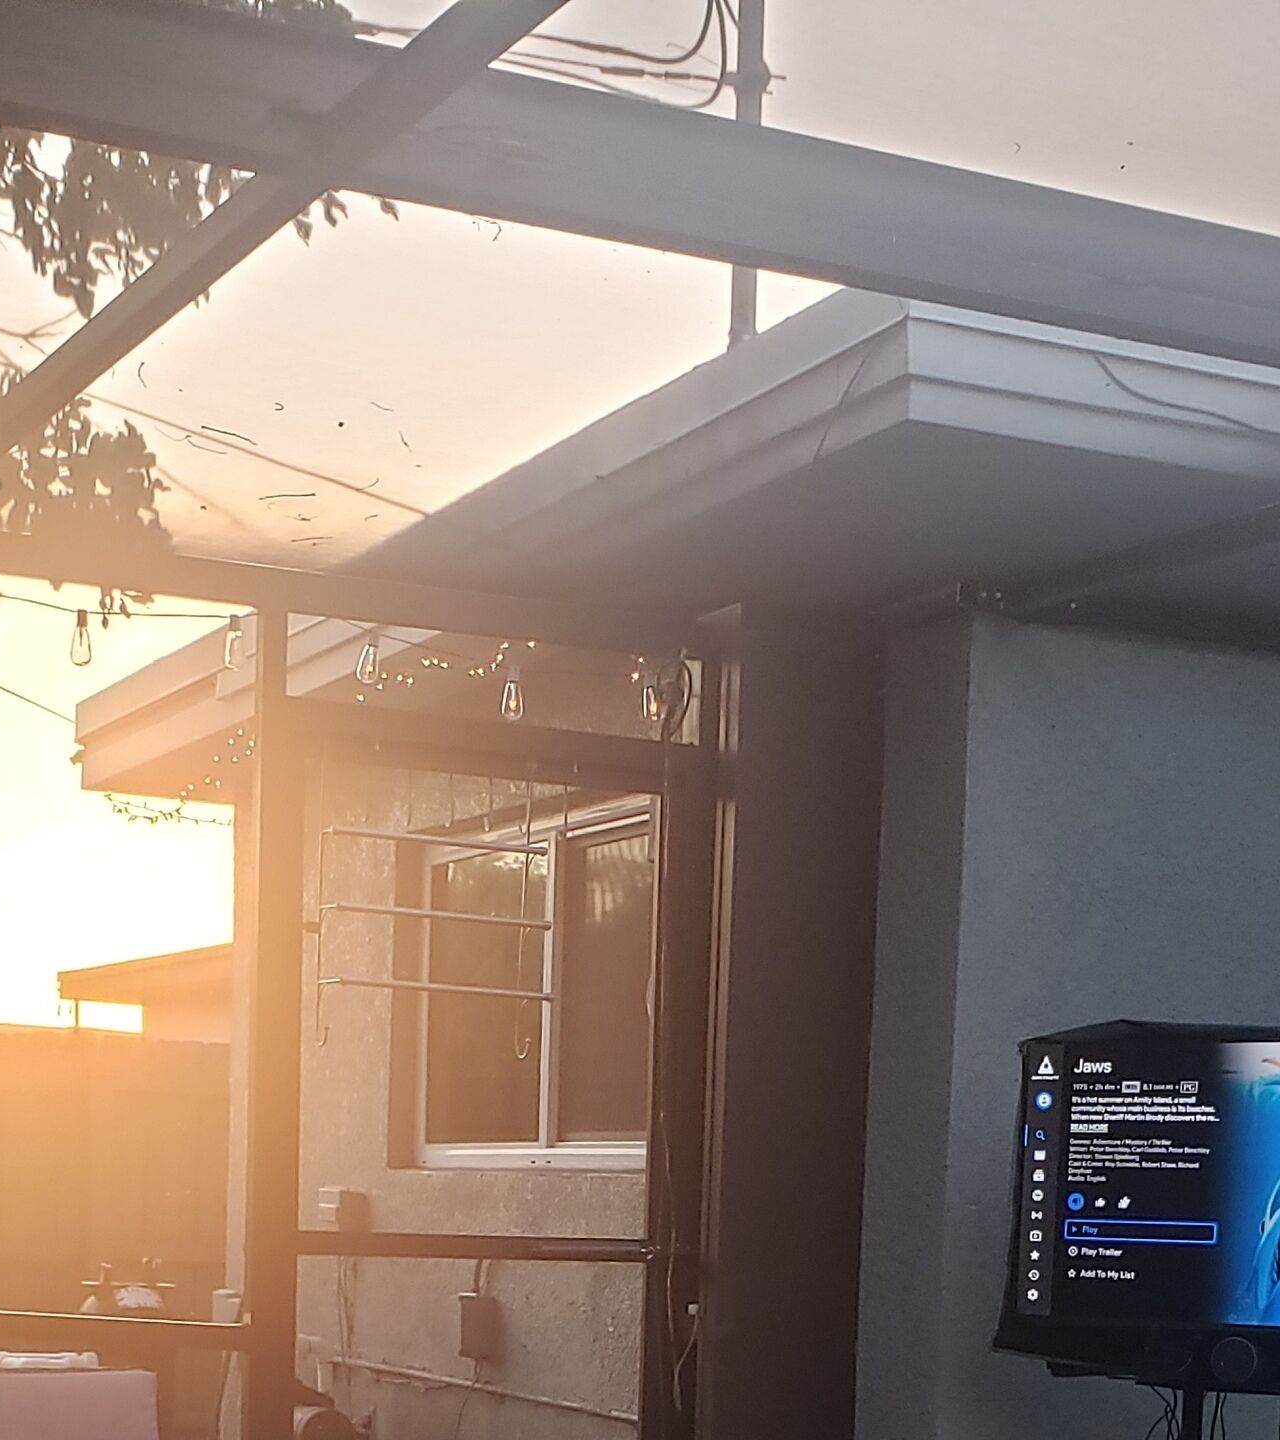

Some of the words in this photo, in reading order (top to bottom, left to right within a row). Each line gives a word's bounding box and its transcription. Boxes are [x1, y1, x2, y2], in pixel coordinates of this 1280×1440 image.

[1073, 1058, 1112, 1073] Jaws
[1183, 1083, 1196, 1091] PG
[1082, 1225, 1098, 1235] Play
[1081, 1247, 1097, 1257] Play
[1098, 1247, 1123, 1257] Trailer
[1080, 1269, 1096, 1278] Add
[1097, 1270, 1106, 1278] To
[1107, 1270, 1119, 1280] My
[1120, 1271, 1135, 1279] List
